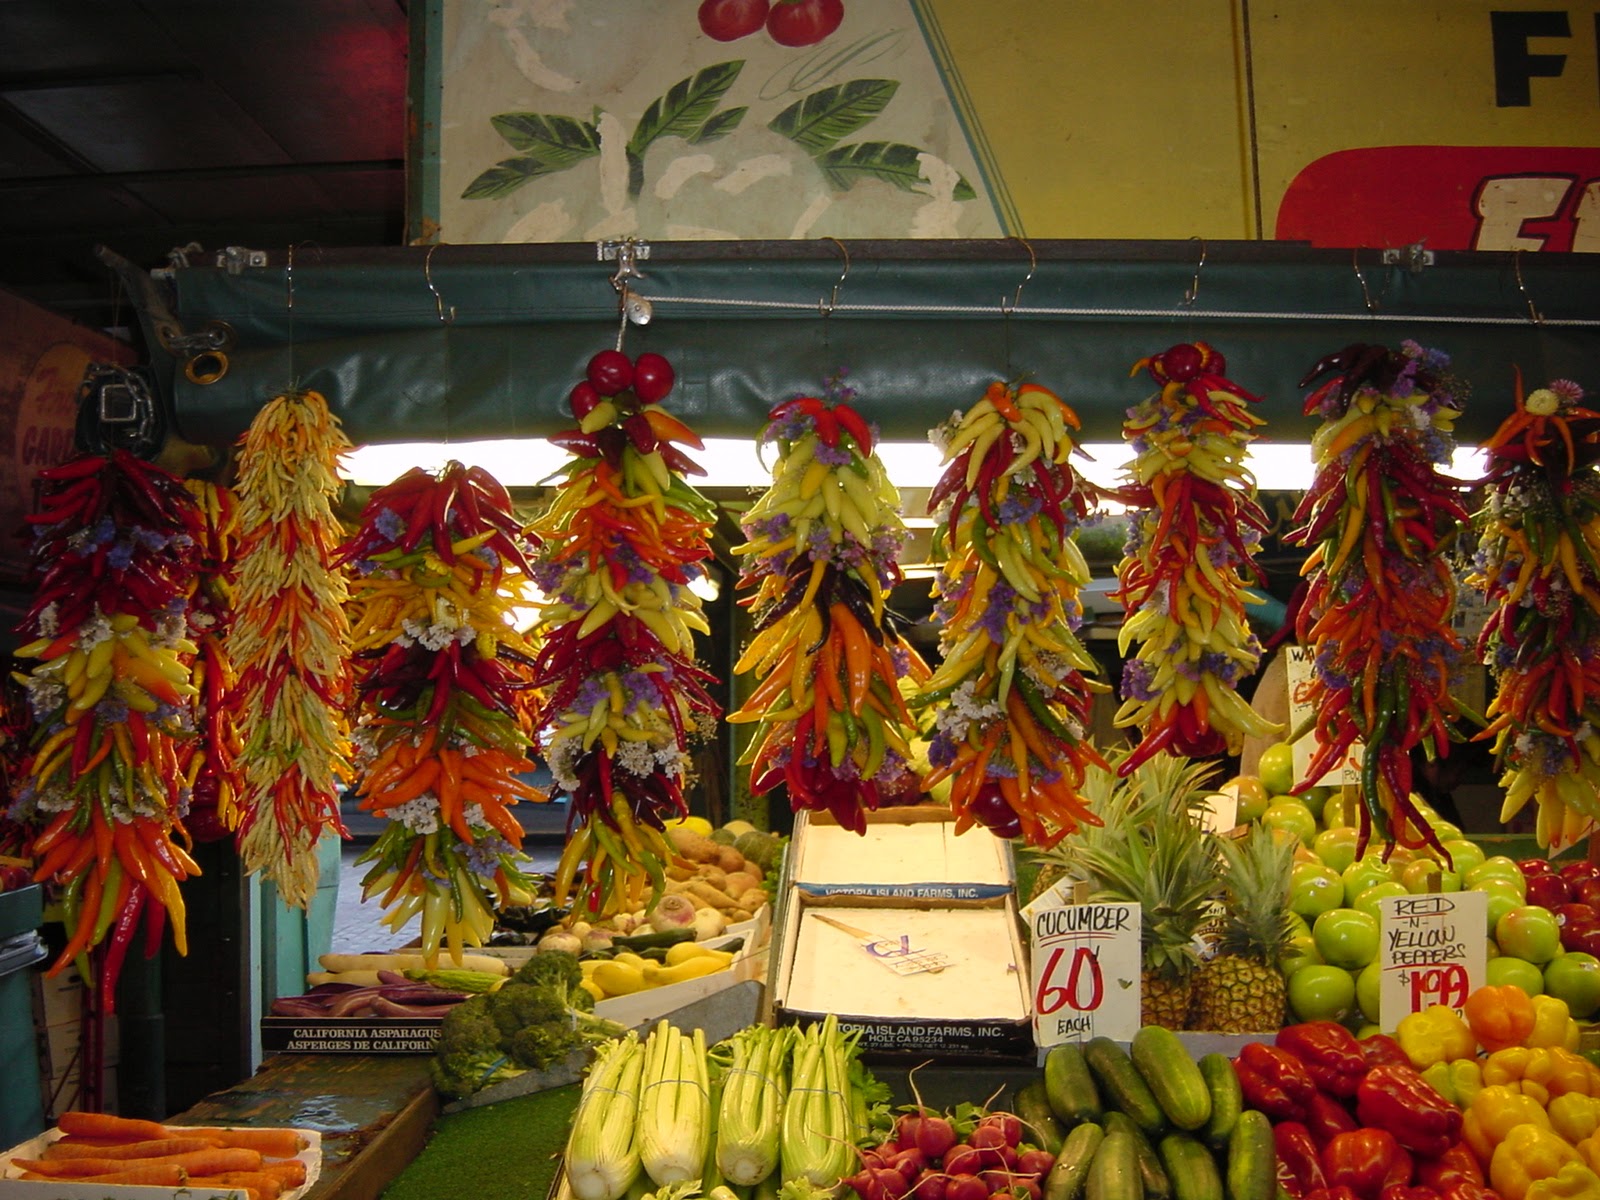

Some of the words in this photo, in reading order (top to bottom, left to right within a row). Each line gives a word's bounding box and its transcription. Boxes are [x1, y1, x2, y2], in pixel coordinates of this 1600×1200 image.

[1490, 11, 1600, 107] F
[957, 889, 979, 899] INC.
[1393, 898, 1456, 916] RED
[1036, 905, 1131, 938] CUCUMBER
[1387, 925, 1456, 951] YELLOW
[1391, 944, 1466, 965] PEPPERS
[1036, 947, 1104, 1015] 60
[293, 1029, 368, 1039] CALIFORNIA
[370, 1028, 442, 1039] ASPARAGUS
[876, 1025, 925, 1036] ISLAND
[927, 1026, 975, 1038] FARMS,
[977, 1027, 1005, 1037] INC.
[1057, 1016, 1091, 1035] EACH
[286, 1040, 350, 1051] ASPERGES
[353, 1040, 370, 1050] DE
[896, 1035, 911, 1043] CA
[912, 1036, 944, 1044] 95234
